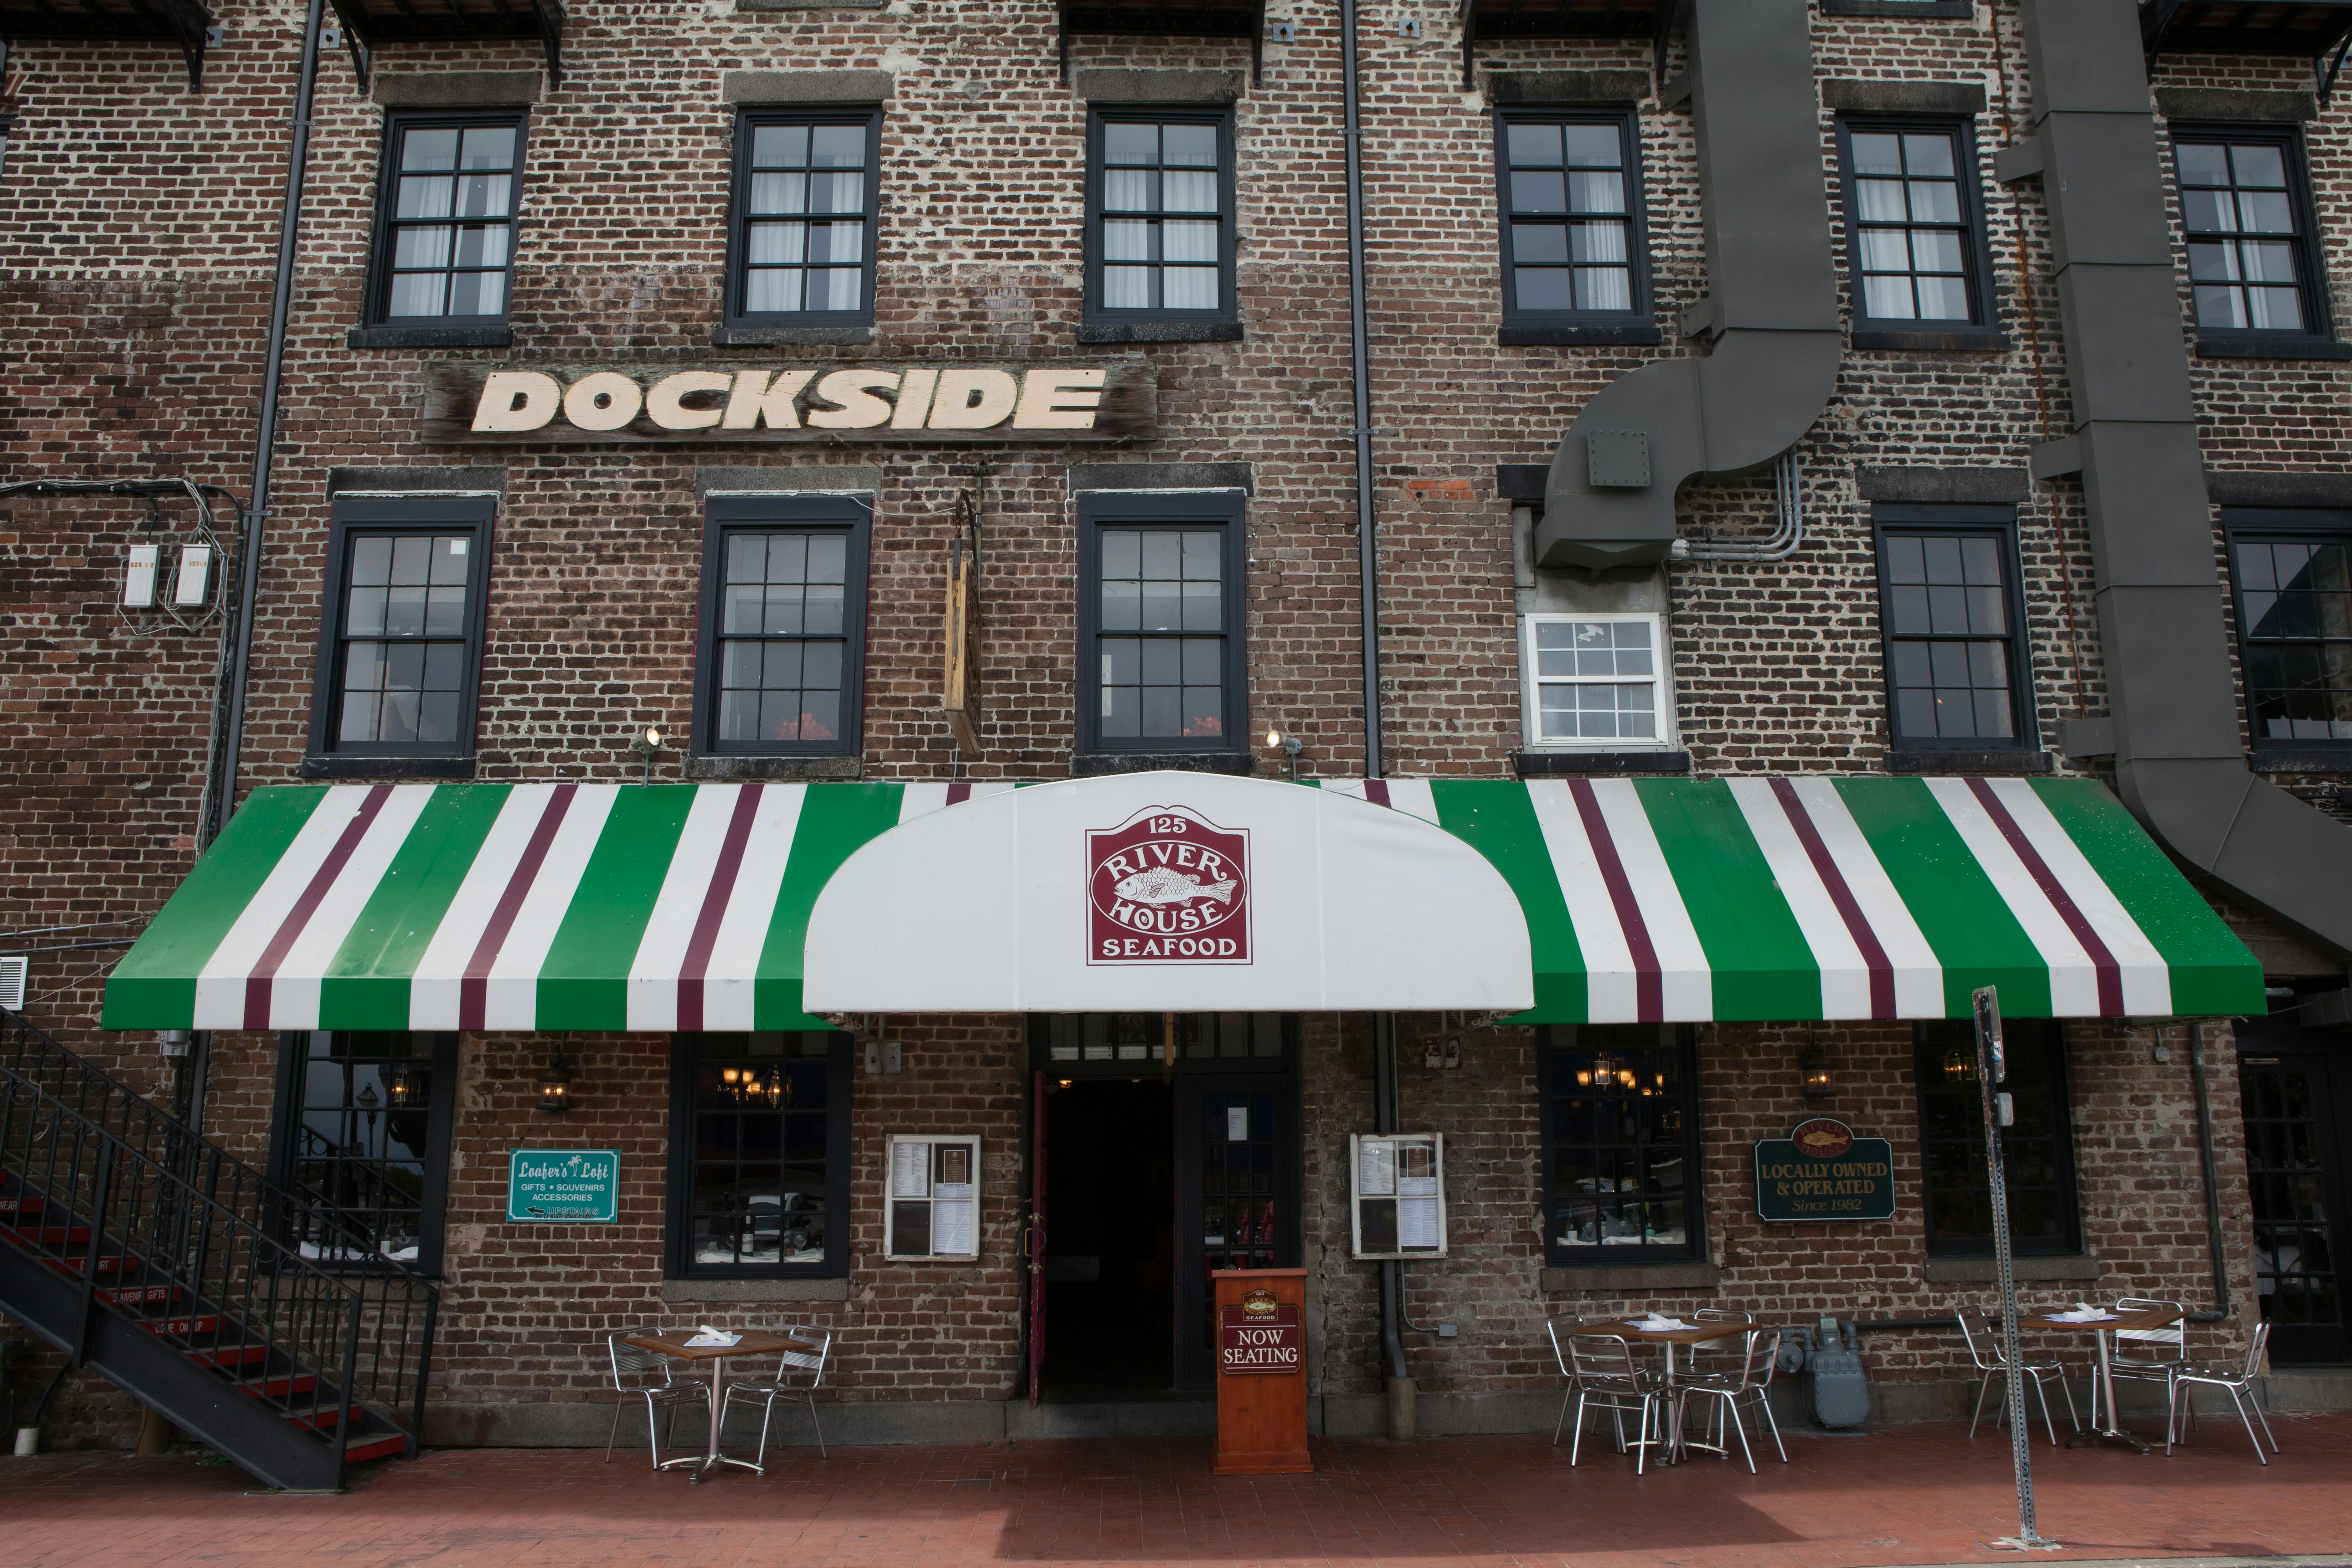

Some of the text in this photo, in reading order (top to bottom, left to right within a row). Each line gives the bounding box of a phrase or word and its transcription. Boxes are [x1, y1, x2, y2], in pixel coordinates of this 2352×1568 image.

[471, 369, 1106, 431] DOCKSIDE
[1149, 817, 1186, 833] 125
[1104, 844, 1227, 882] RIVER
[1109, 897, 1222, 932] HOUSE
[1102, 938, 1236, 956] SEAFOOD
[1800, 1122, 1845, 1136] RIVER
[1802, 1143, 1844, 1156] HOUSE
[518, 1162, 609, 1180] Loafer's Loft
[1762, 1163, 1888, 1179] LOCALLY OWNED
[1777, 1180, 1875, 1196] & OPERATED
[1792, 1199, 1862, 1211] Since 1982
[180, 1323, 188, 1333] ON
[195, 1321, 203, 1331] UP
[1238, 1330, 1284, 1345] NOW
[1224, 1347, 1298, 1364] SEATING
